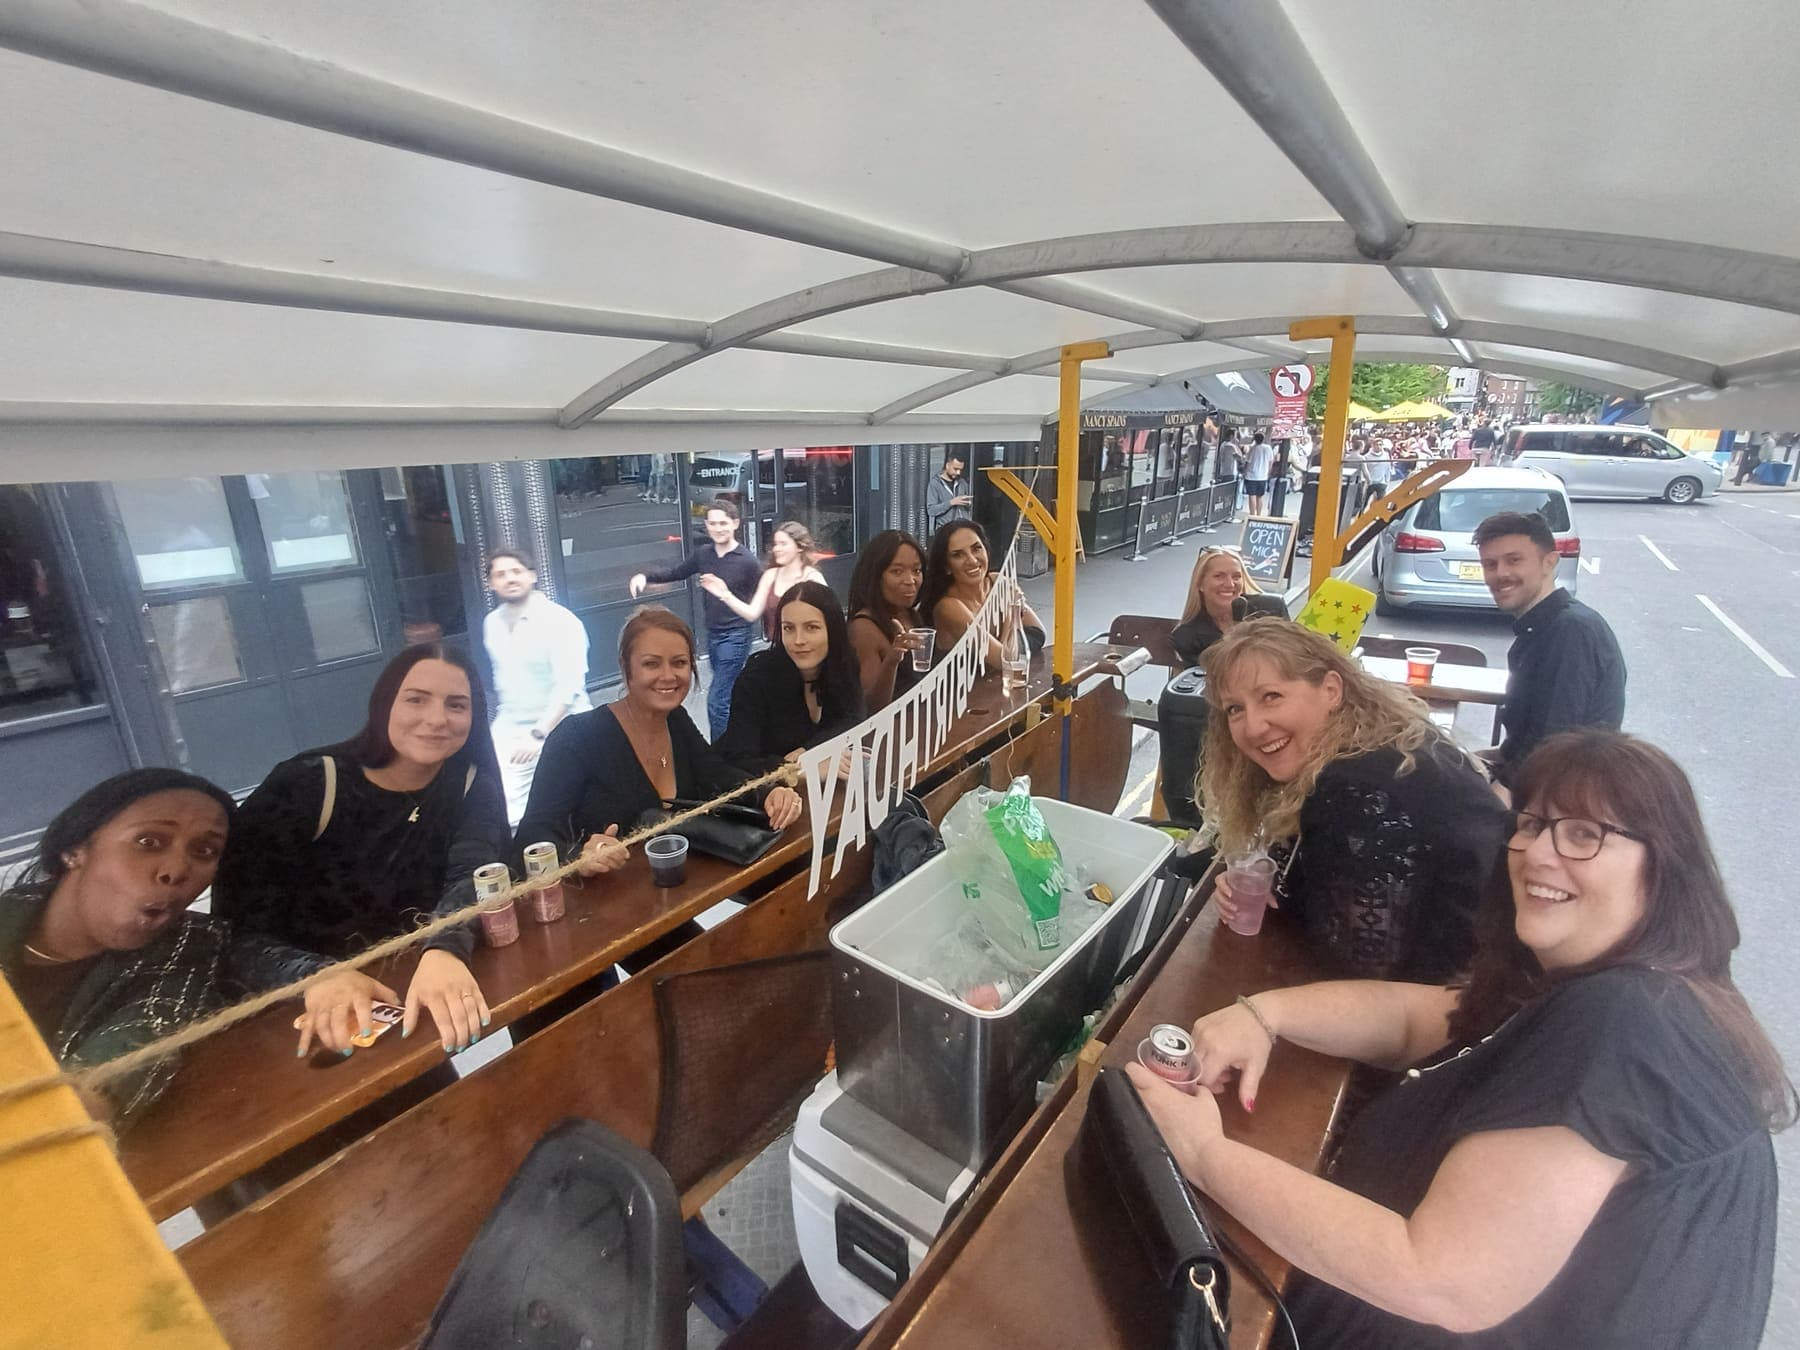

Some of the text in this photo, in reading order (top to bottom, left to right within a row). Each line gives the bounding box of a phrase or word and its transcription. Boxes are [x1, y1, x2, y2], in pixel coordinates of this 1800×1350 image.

[1083, 415, 1105, 427] NANCY
[1249, 528, 1285, 546] OPEN
[1251, 545, 1271, 558] MIC
